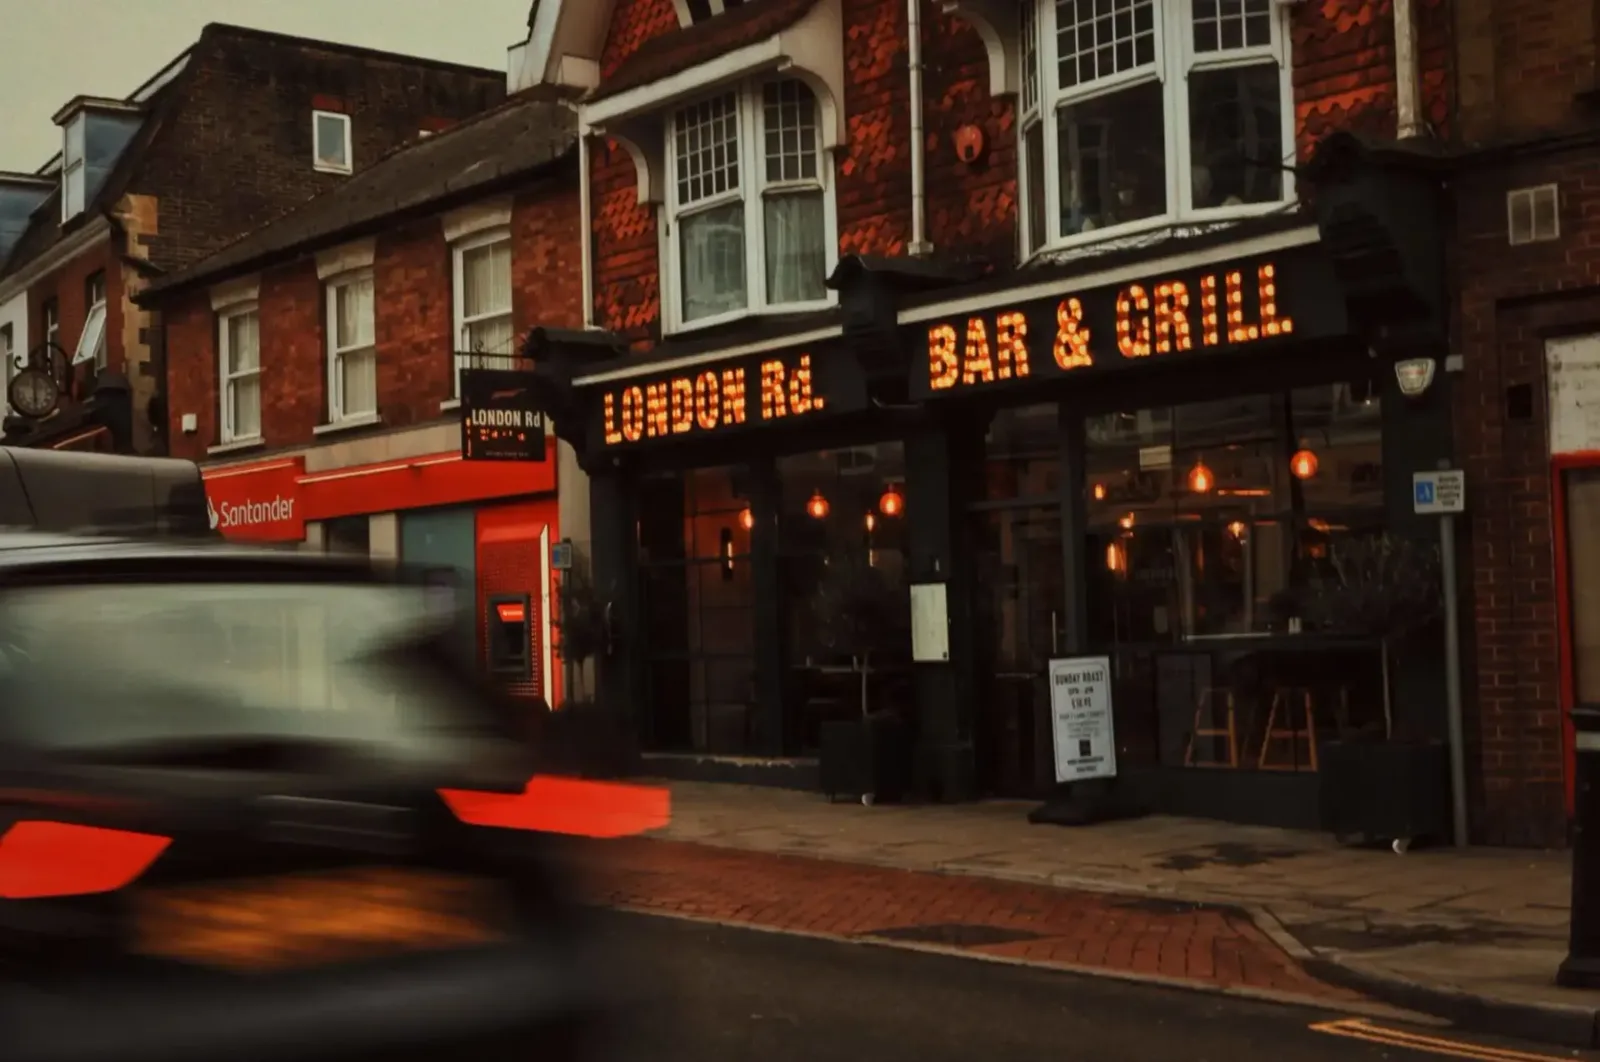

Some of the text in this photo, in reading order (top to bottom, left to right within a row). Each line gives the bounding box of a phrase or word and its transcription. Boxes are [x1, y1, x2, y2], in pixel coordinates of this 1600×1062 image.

[928, 263, 1293, 391] BAR & GRILL
[472, 409, 541, 427] LONDON Rd
[604, 354, 824, 445] LONDON Rd.
[221, 494, 294, 527] Santander
